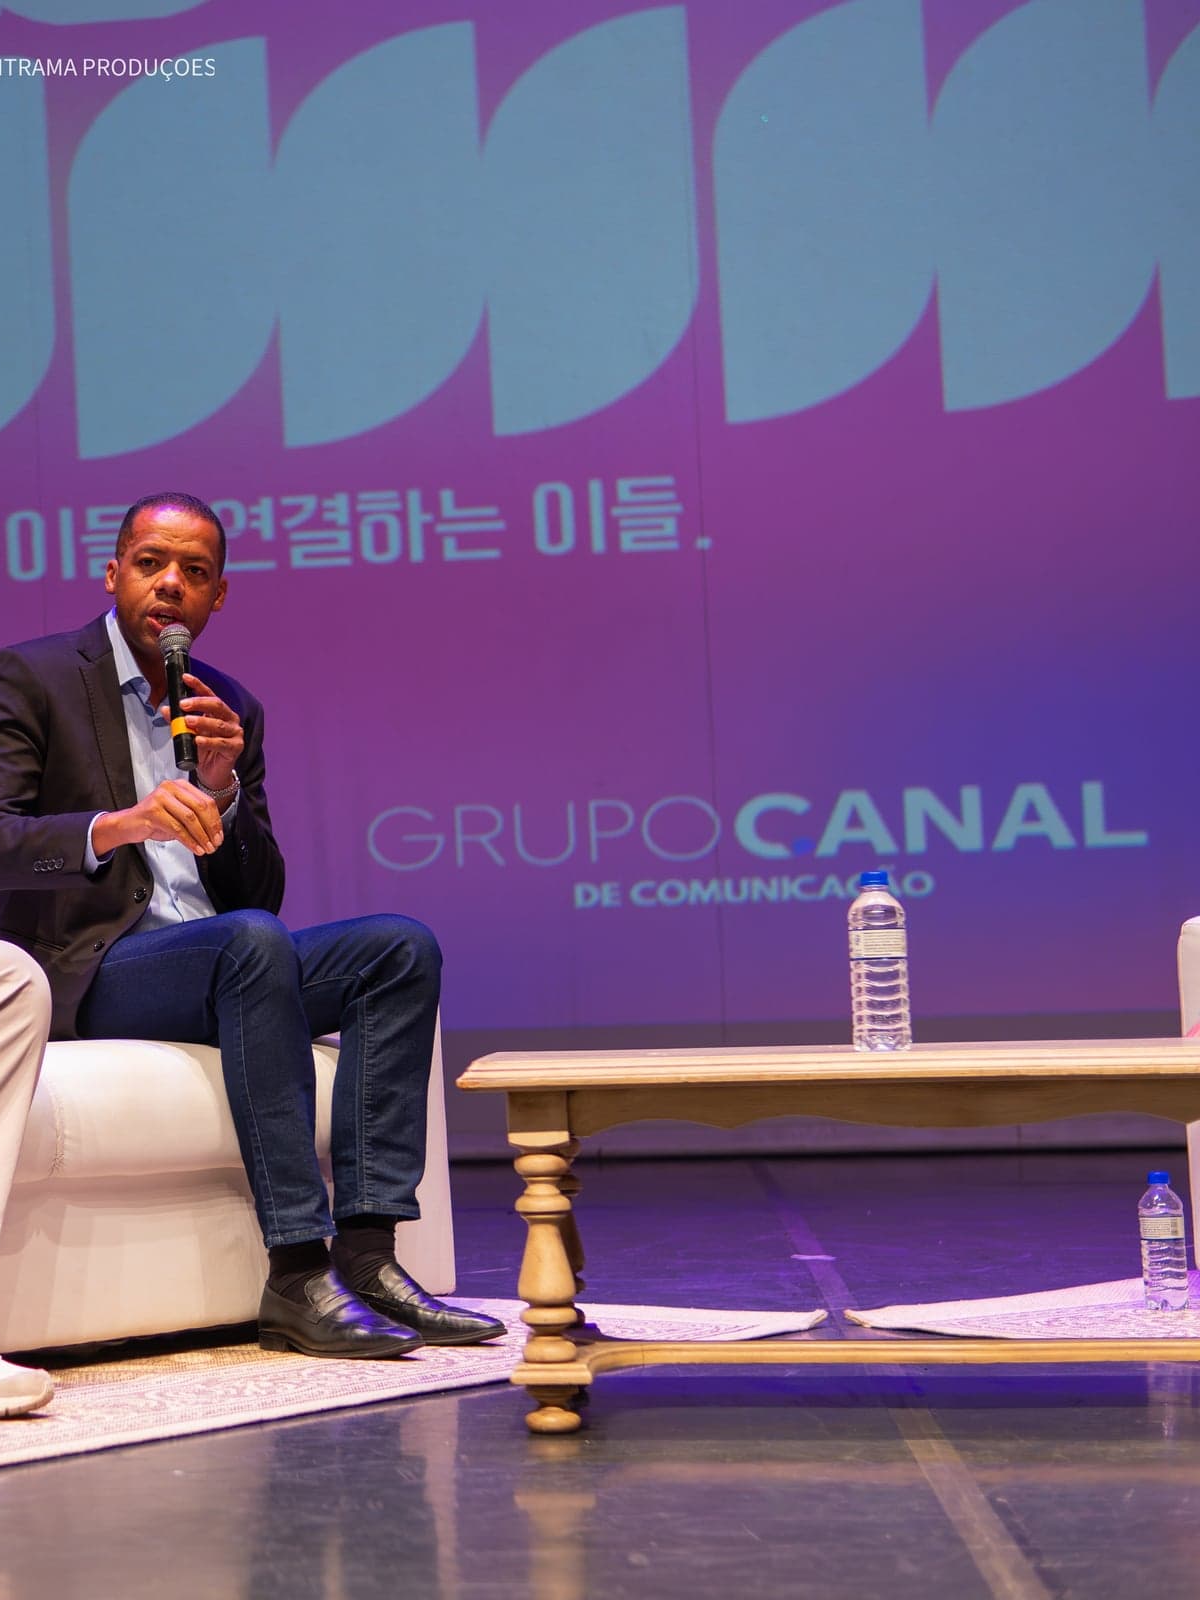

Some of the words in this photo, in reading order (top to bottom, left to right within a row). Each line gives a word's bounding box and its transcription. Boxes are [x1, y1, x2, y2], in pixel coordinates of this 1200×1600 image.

[211, 487, 506, 574] 연결하는
[533, 476, 713, 556] 이들.
[367, 796, 722, 872] GRUPO
[574, 882, 621, 910] DE
